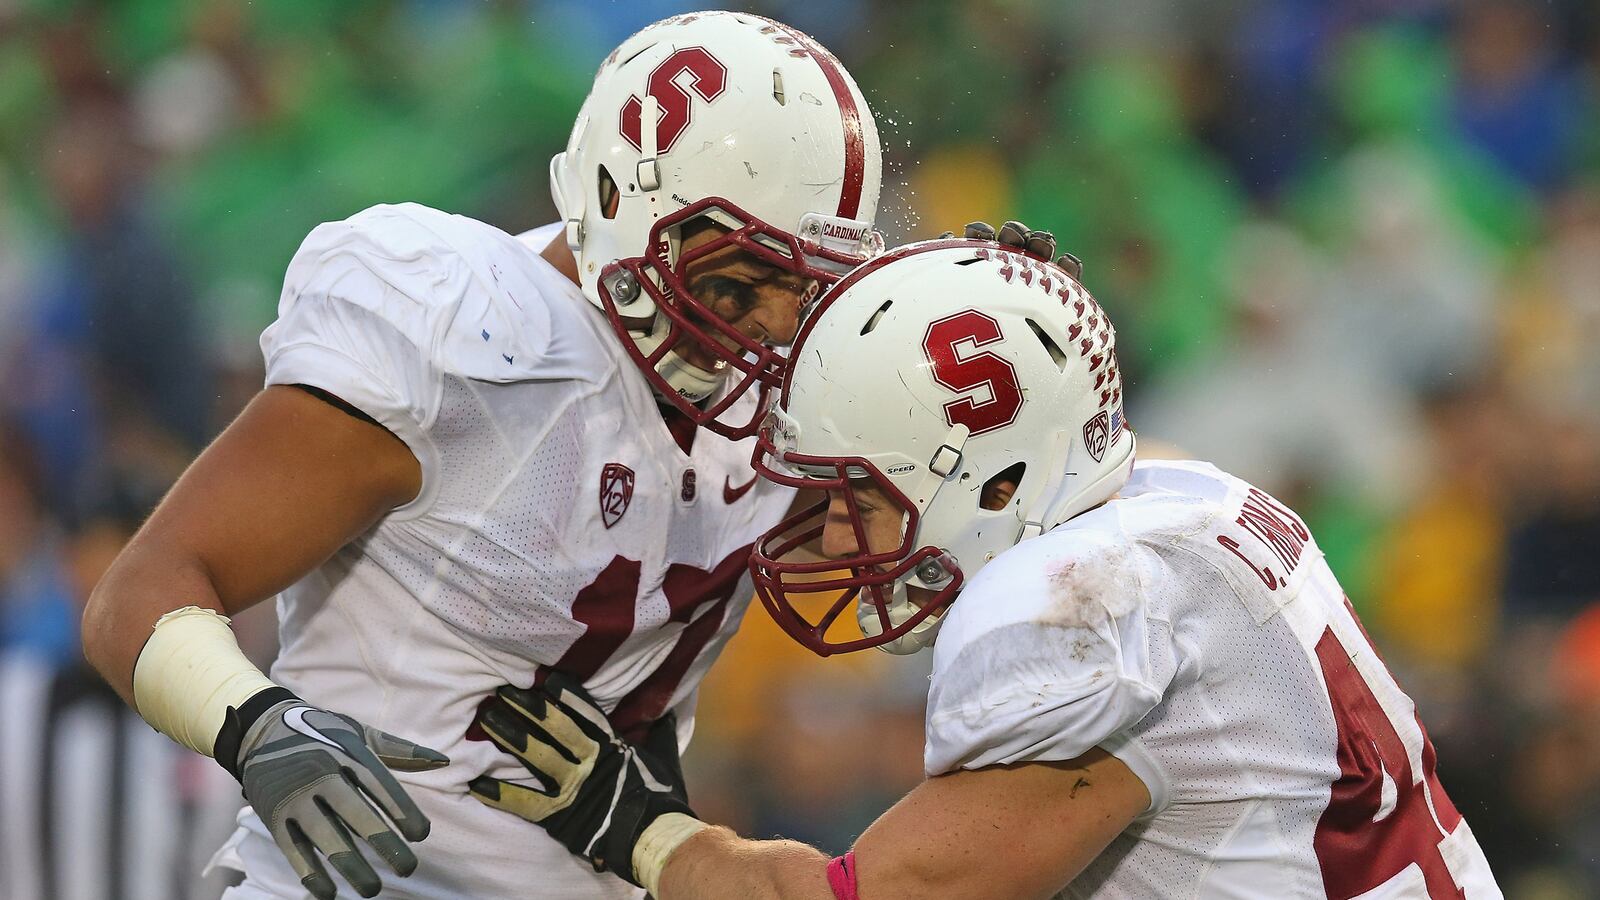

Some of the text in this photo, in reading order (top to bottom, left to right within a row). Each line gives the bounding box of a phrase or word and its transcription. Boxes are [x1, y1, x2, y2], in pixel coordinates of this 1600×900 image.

[619, 46, 728, 156] S
[922, 309, 1024, 438] S
[1085, 414, 1108, 450] PAC
[1092, 434, 1105, 456] 12
[681, 468, 697, 502] S
[887, 465, 915, 474] SPEED
[604, 492, 622, 516] 12
[1217, 535, 1287, 591] C.
[1313, 592, 1464, 900] 4
